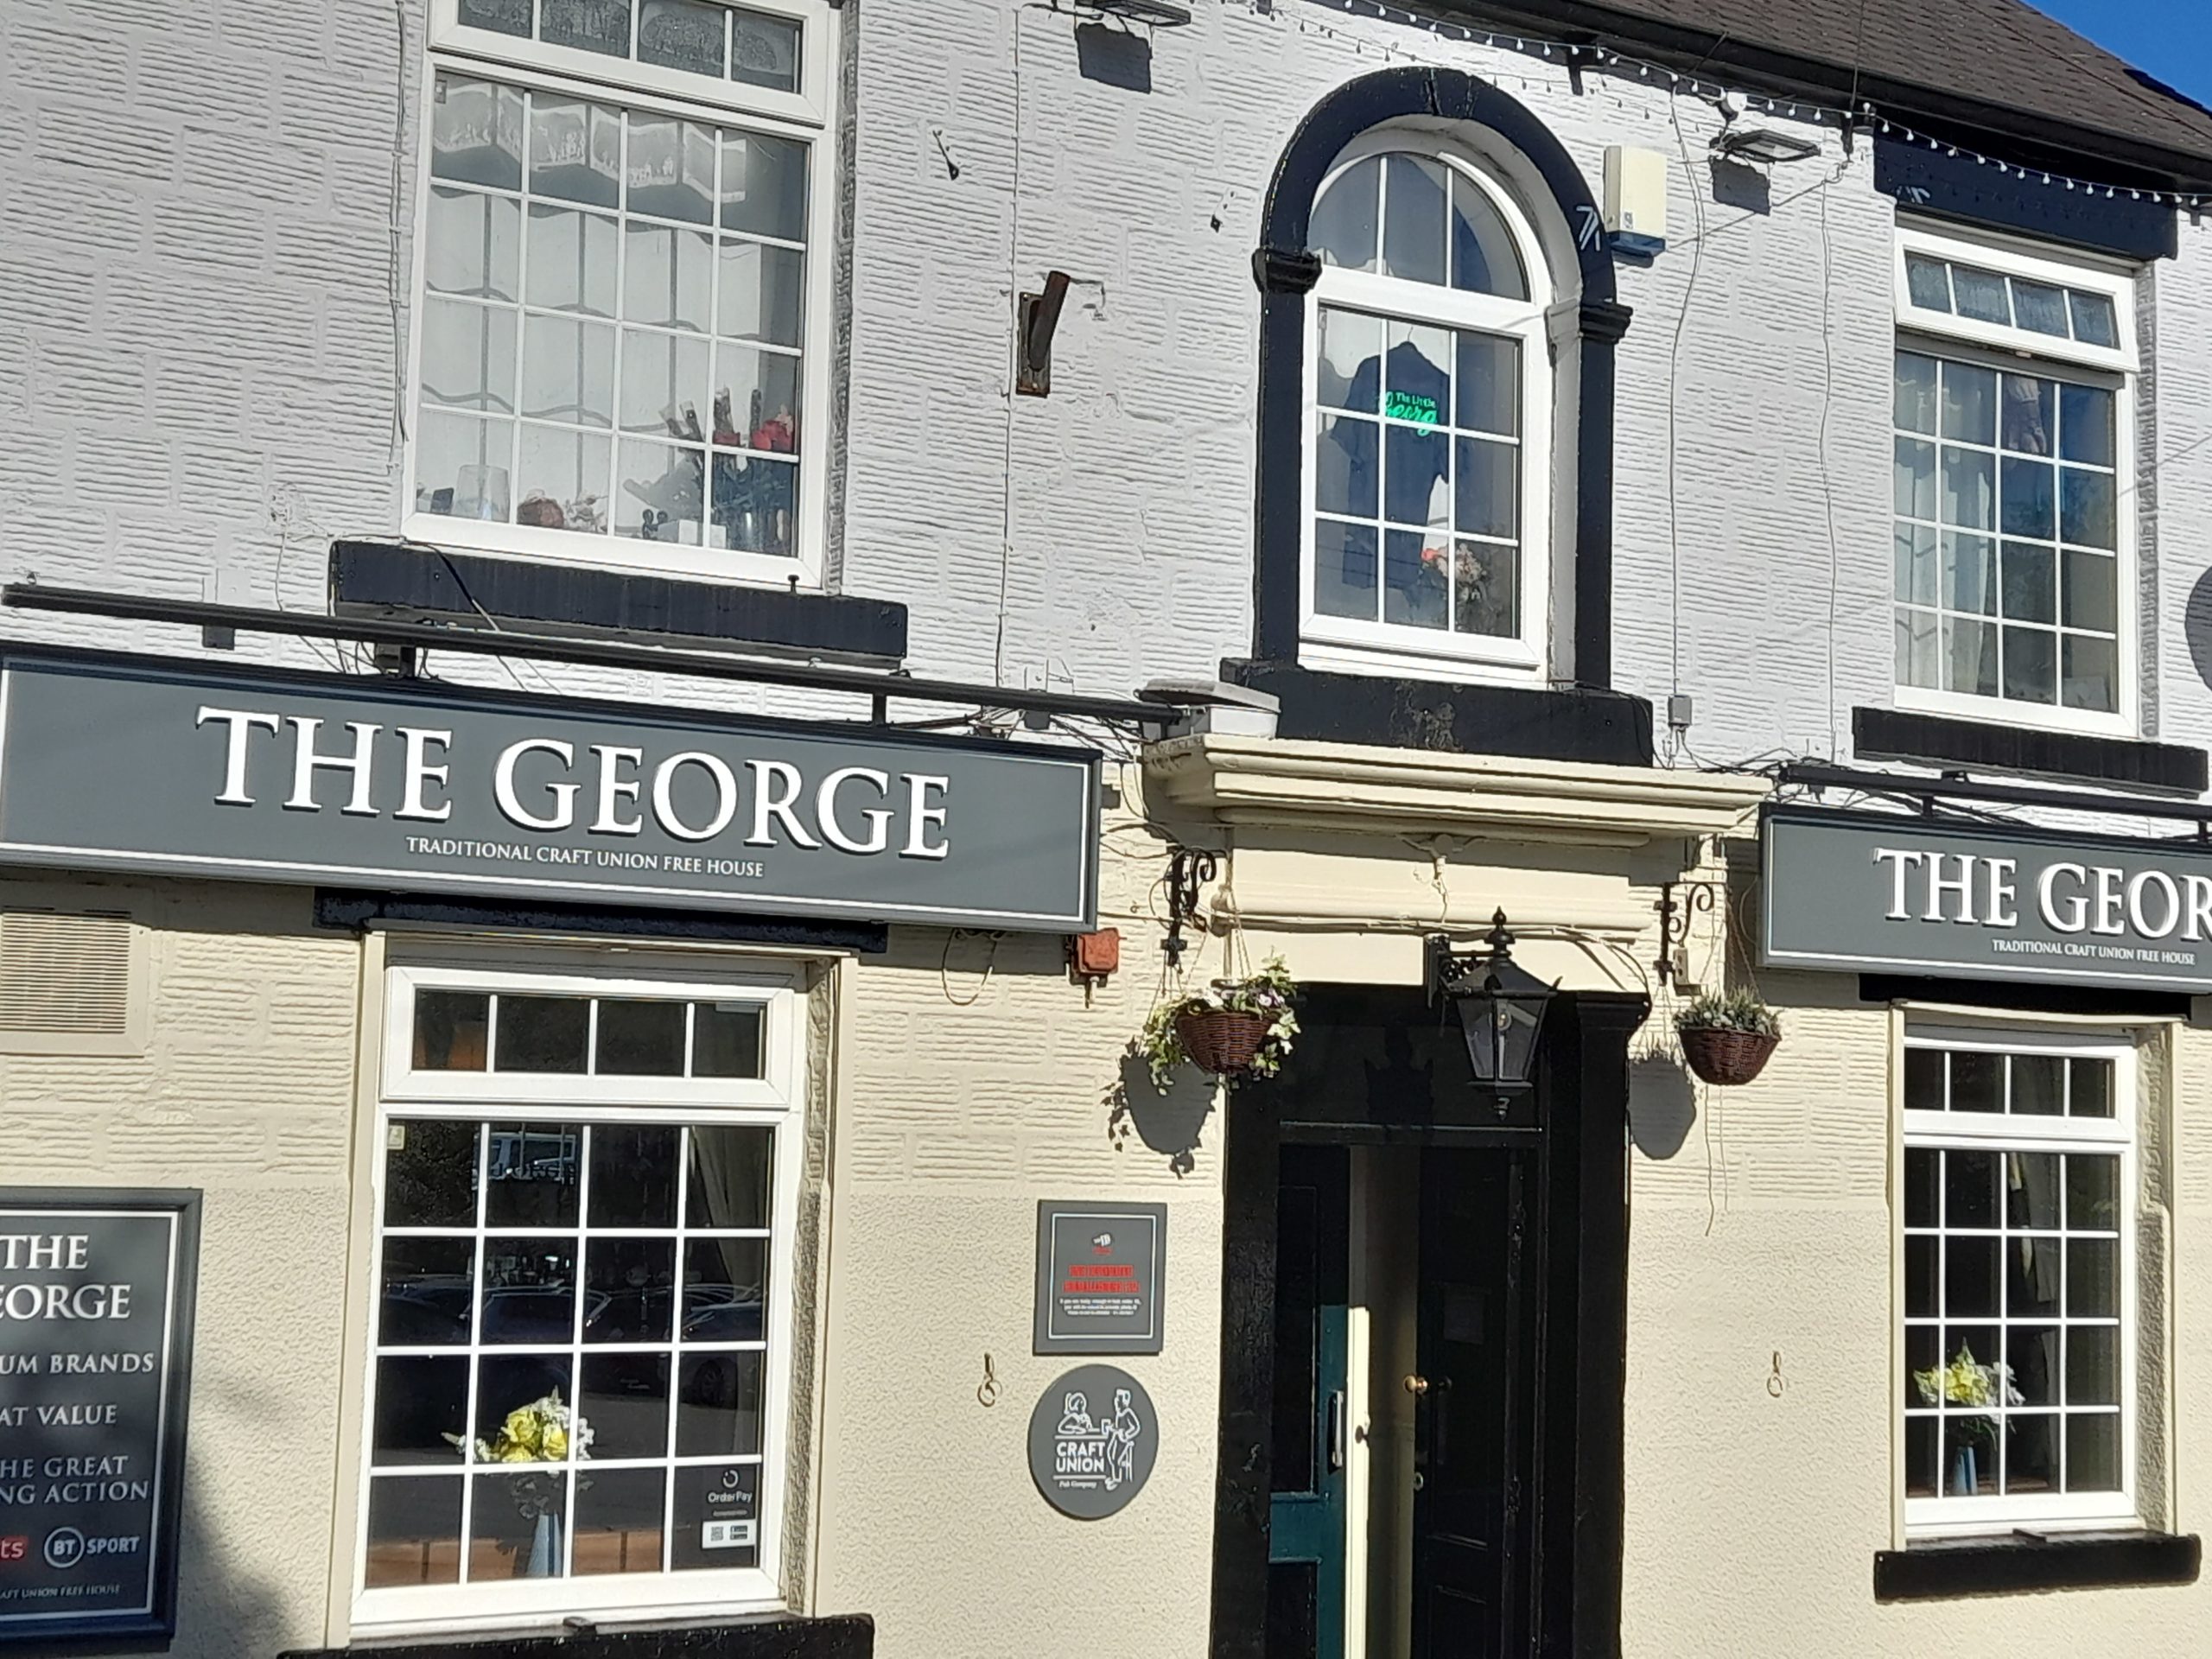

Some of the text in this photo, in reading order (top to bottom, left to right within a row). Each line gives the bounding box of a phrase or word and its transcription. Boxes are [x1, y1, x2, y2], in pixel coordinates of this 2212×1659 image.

[196, 705, 950, 860] THE GEORGE
[406, 836, 765, 878] TRADITIONAL CRAFT UNION FREE HOUSE
[1873, 847, 2018, 928] THE
[1993, 939, 2196, 965] TRADITIONAL CRAFT UNION FREE HOUSE
[0, 1235, 89, 1269] THE
[0, 1284, 131, 1320] ORGE
[49, 1352, 155, 1374] BRANDS
[36, 1404, 118, 1426] VALUE
[1056, 1441, 1106, 1458] CRAFT
[43, 1455, 129, 1478] GREAT
[1056, 1457, 1105, 1472] UNION
[44, 1480, 149, 1503] ACTION
[53, 1539, 77, 1556] BT
[86, 1536, 140, 1554] SPORT
